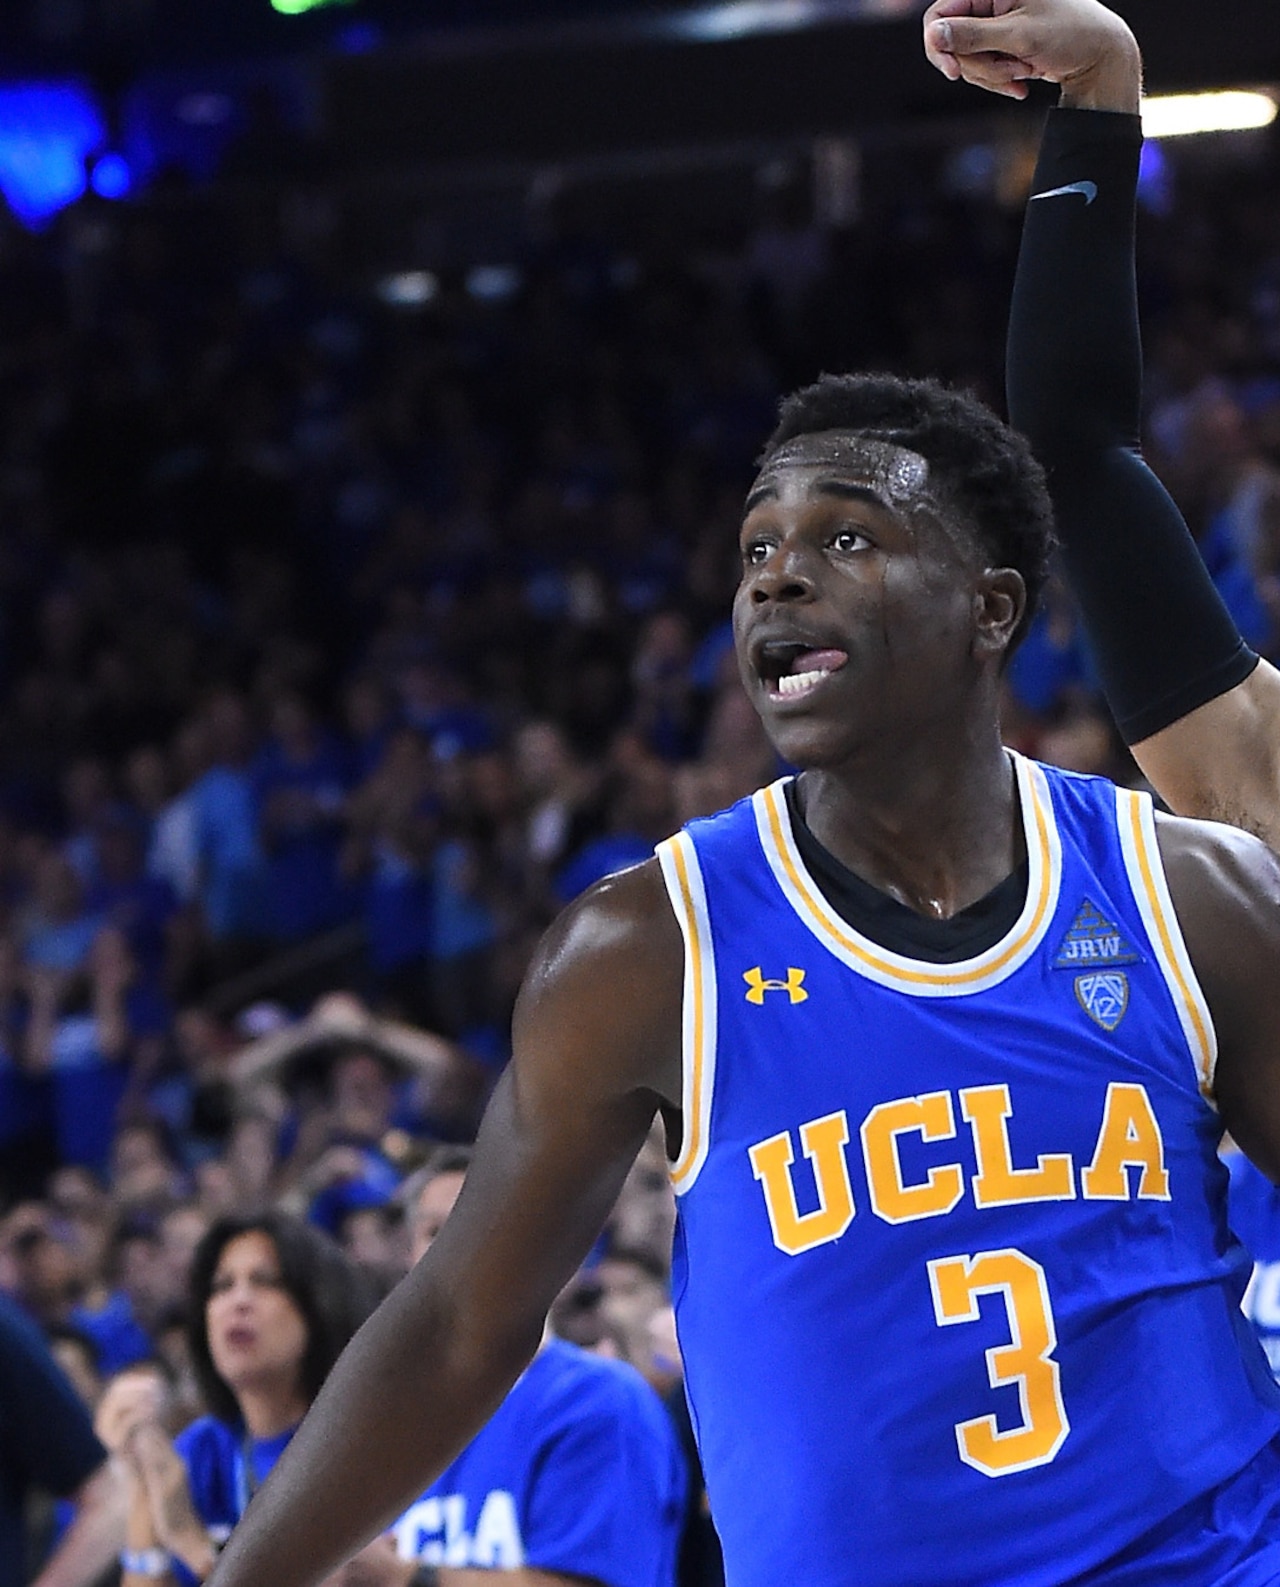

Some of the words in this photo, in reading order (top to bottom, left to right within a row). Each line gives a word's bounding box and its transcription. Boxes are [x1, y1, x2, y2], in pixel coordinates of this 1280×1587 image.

[1066, 936, 1120, 958] JRW
[1094, 997, 1118, 1019] 12
[748, 1082, 1171, 1256] UCLA
[926, 1247, 1071, 1478] 3
[396, 1489, 524, 1570] CLA
